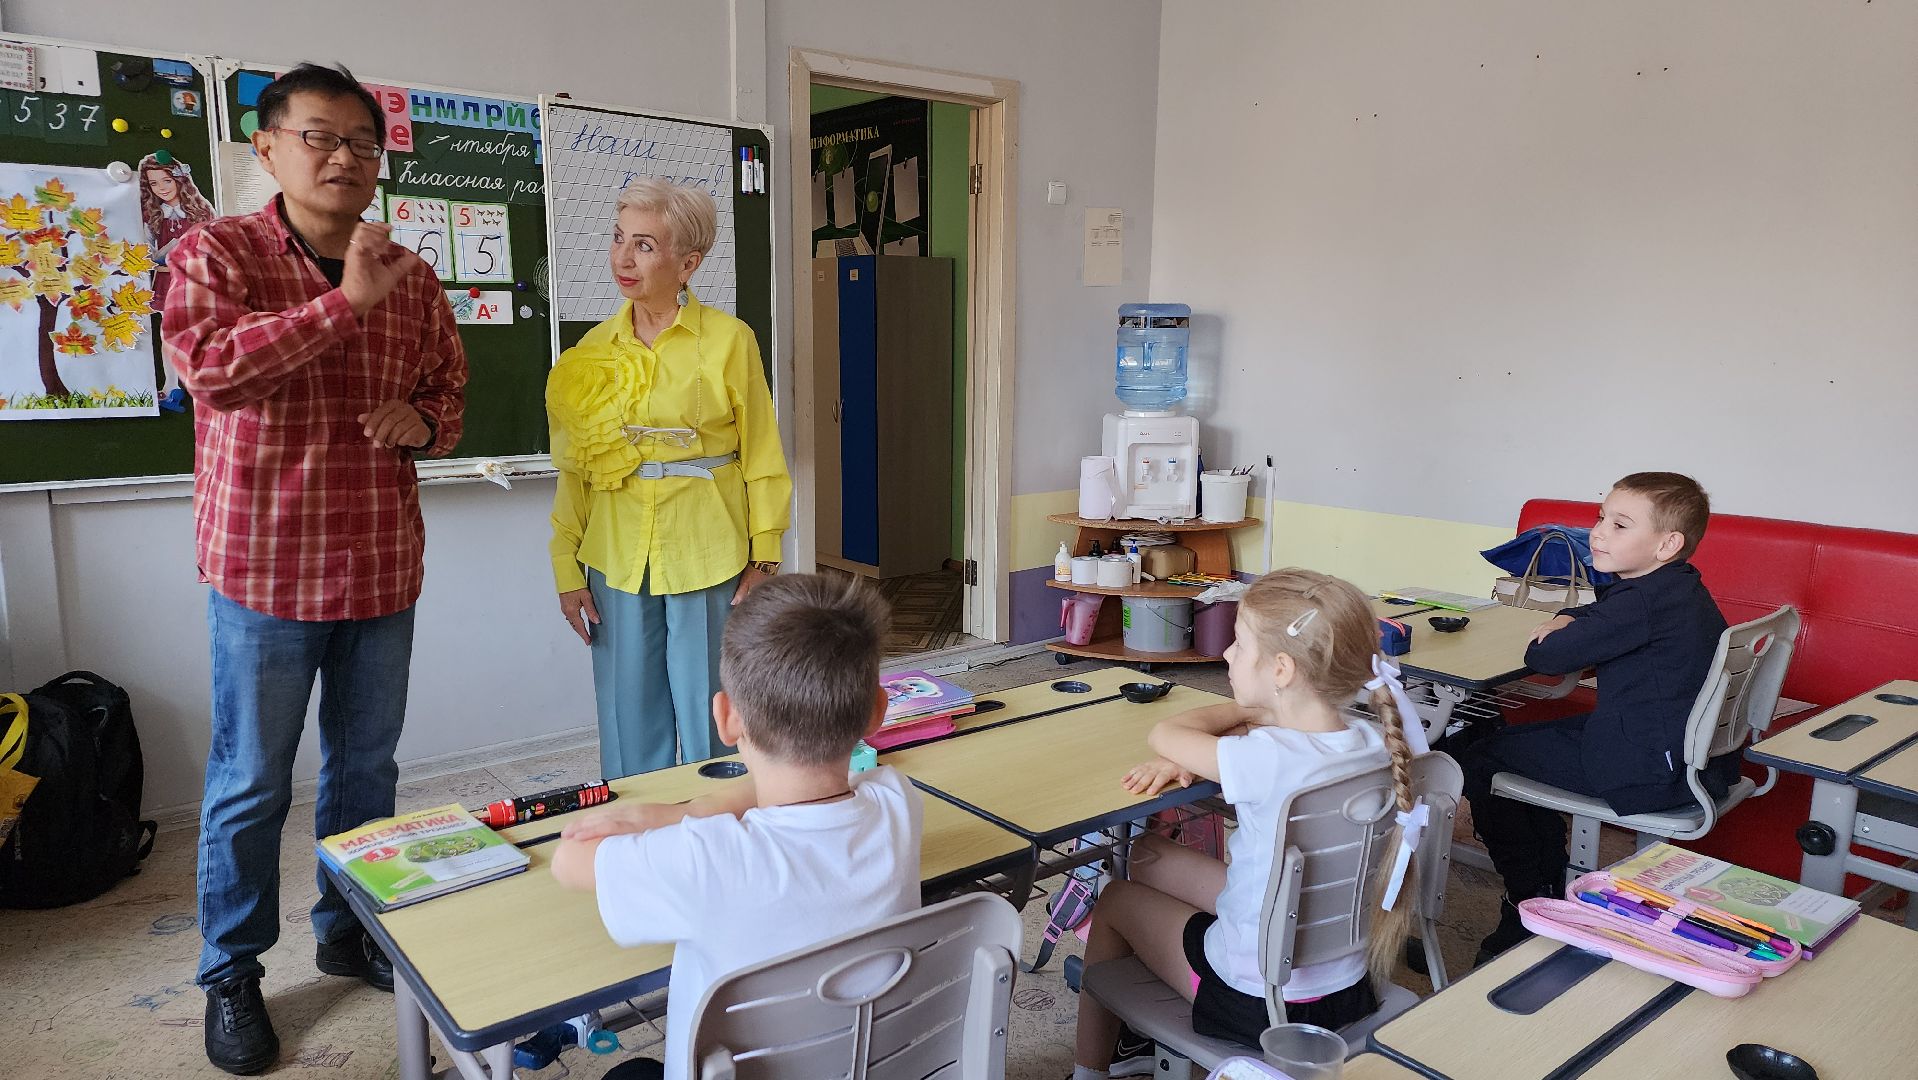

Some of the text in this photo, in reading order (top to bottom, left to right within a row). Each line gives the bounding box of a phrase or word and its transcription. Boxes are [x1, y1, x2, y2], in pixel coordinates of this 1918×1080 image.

[14, 95, 100, 131] 5 3 7
[571, 124, 657, 159] Наш
[810, 125, 880, 150] ИНФОРМАТИКА
[398, 160, 506, 190] Классная
[397, 201, 410, 220] 6
[459, 207, 471, 226] 5
[417, 230, 442, 268] 6
[473, 235, 501, 275] 5
[338, 813, 461, 850] МАТЕМАТИКА
